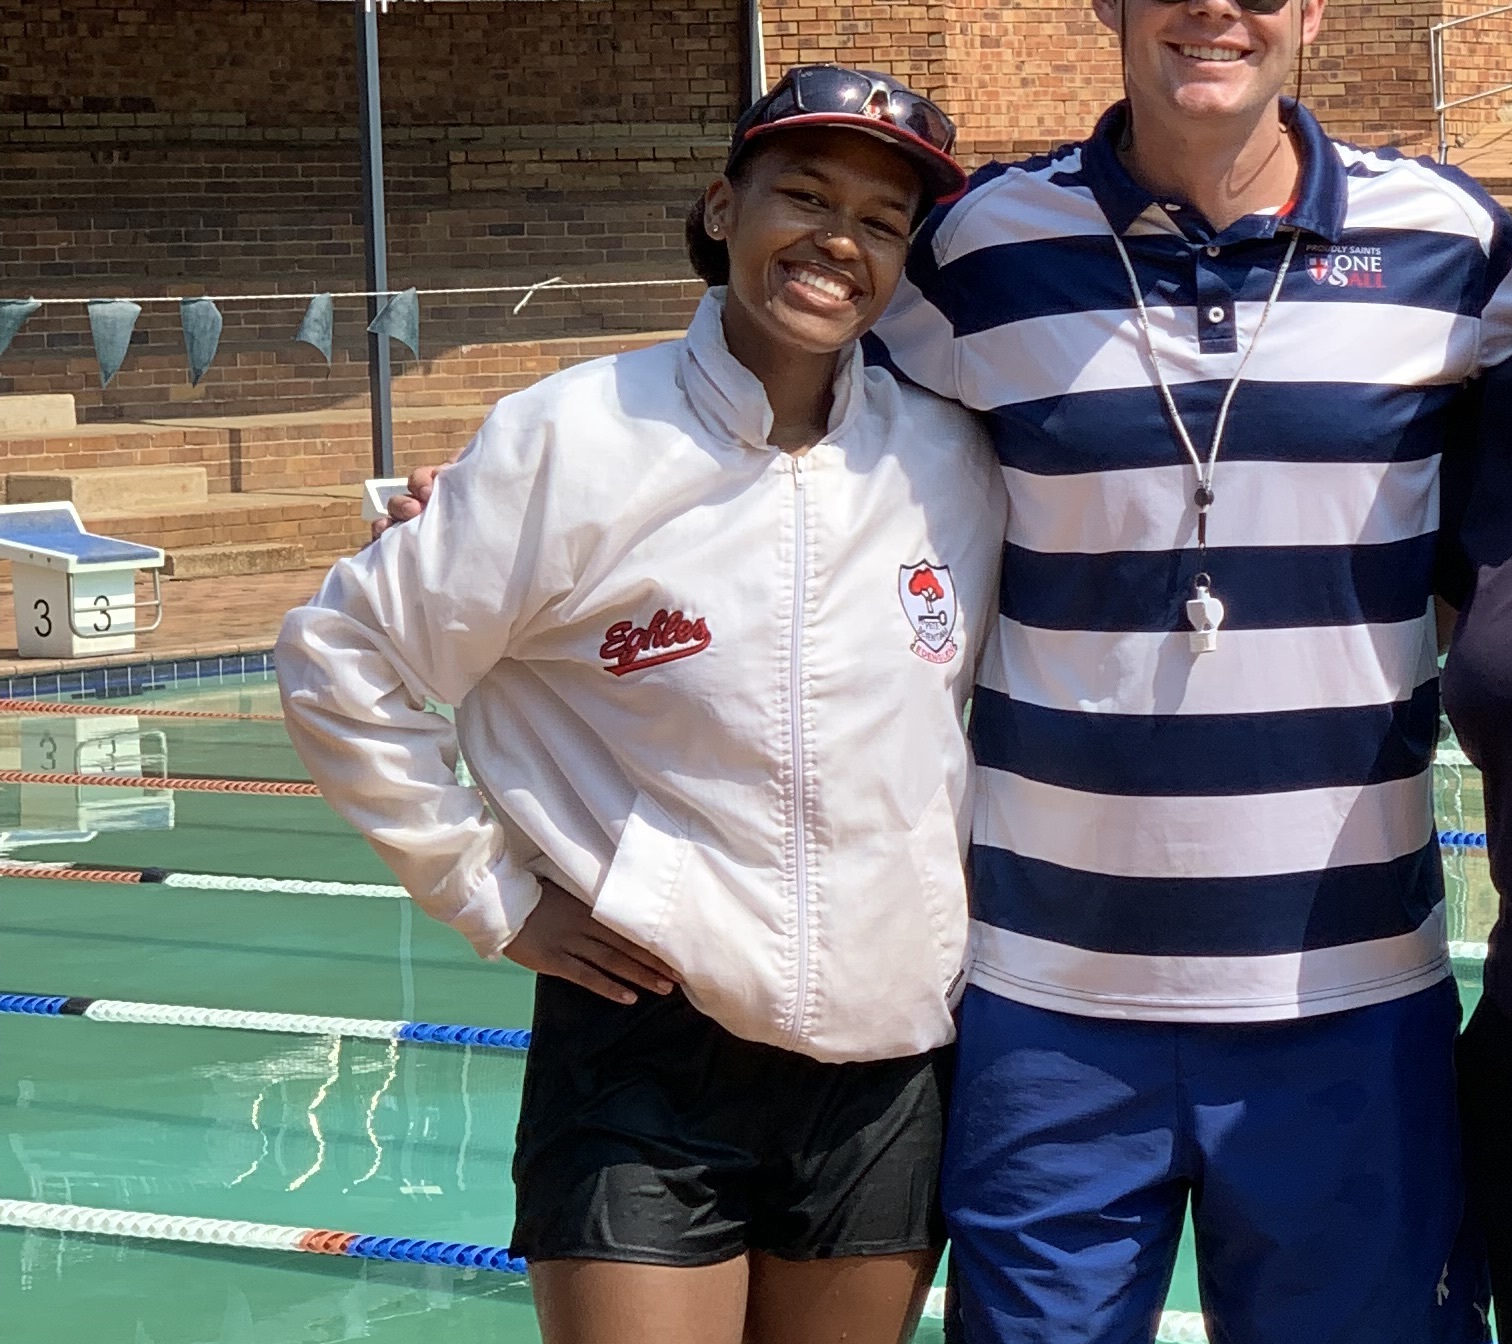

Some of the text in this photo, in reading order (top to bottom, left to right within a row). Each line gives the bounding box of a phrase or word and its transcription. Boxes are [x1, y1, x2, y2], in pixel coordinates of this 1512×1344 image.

[1349, 245, 1381, 255] SAINTS
[1335, 254, 1383, 272] ONE
[1328, 266, 1387, 288] & ALL
[33, 599, 52, 637] 3
[93, 595, 112, 632] 3
